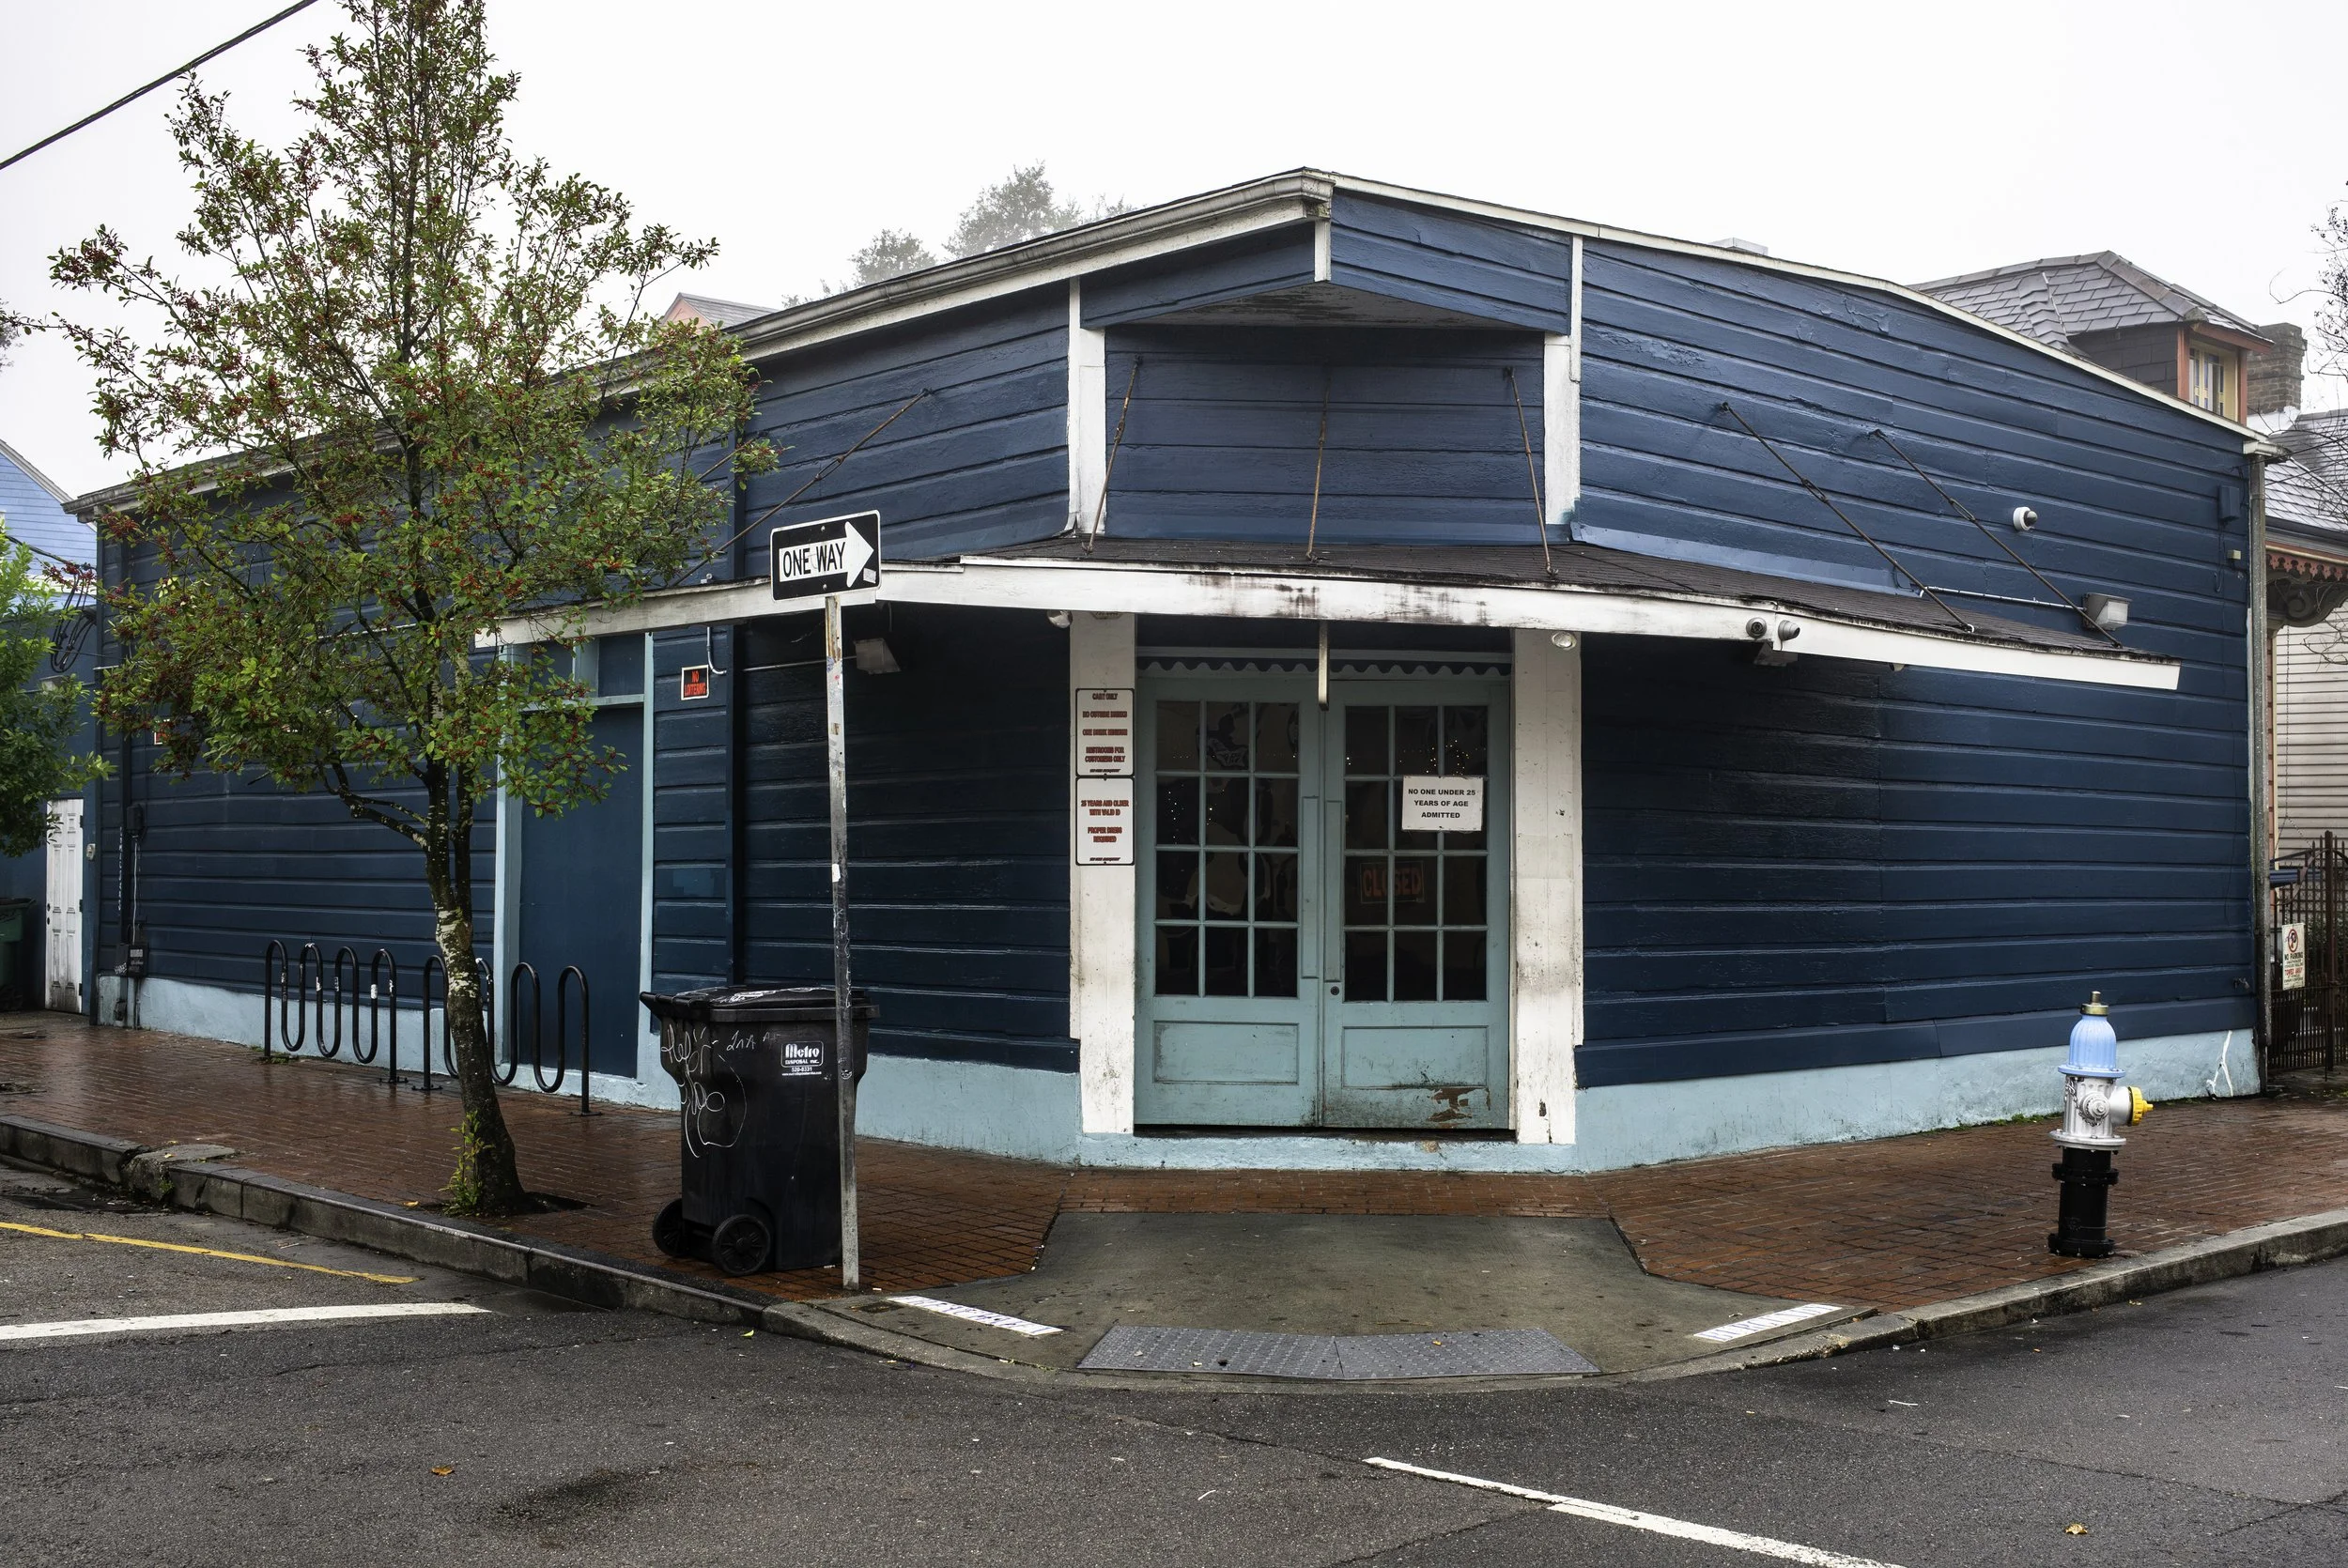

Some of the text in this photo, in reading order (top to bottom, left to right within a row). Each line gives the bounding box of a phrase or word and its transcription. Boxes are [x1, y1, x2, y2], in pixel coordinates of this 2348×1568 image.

[783, 542, 845, 577] ONE WAY
[691, 669, 700, 684] NO
[684, 682, 706, 697] LOITERING
[1105, 692, 1118, 700] ONLY
[785, 1043, 820, 1058] Metro
